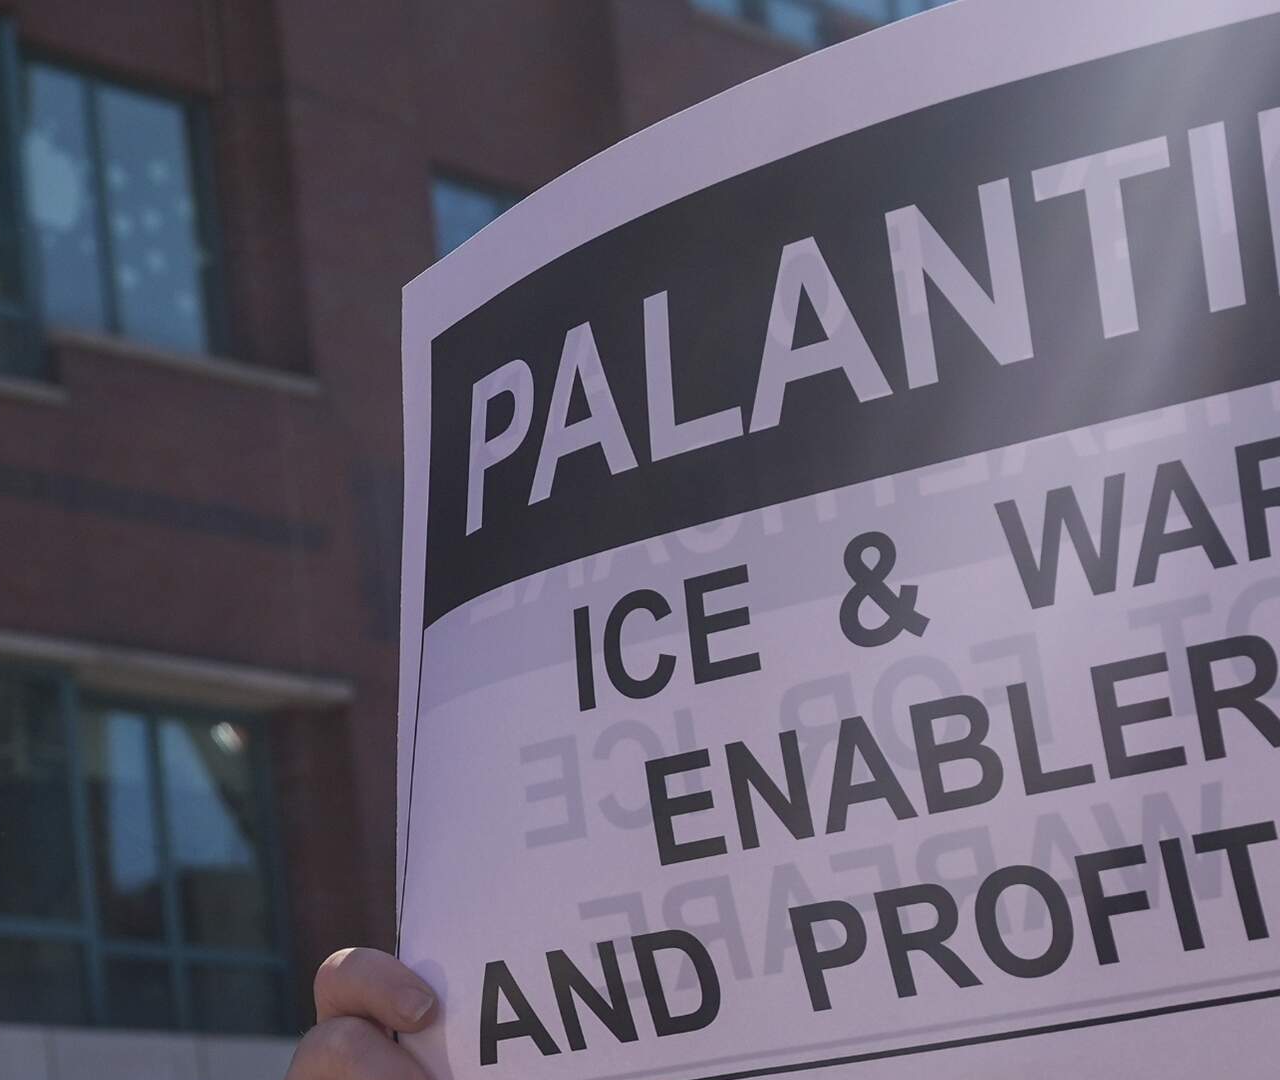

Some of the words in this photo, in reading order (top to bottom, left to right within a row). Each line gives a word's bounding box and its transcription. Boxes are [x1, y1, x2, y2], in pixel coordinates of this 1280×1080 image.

[573, 563, 762, 712] ICE
[839, 531, 931, 648] &
[479, 928, 721, 1066] AND
